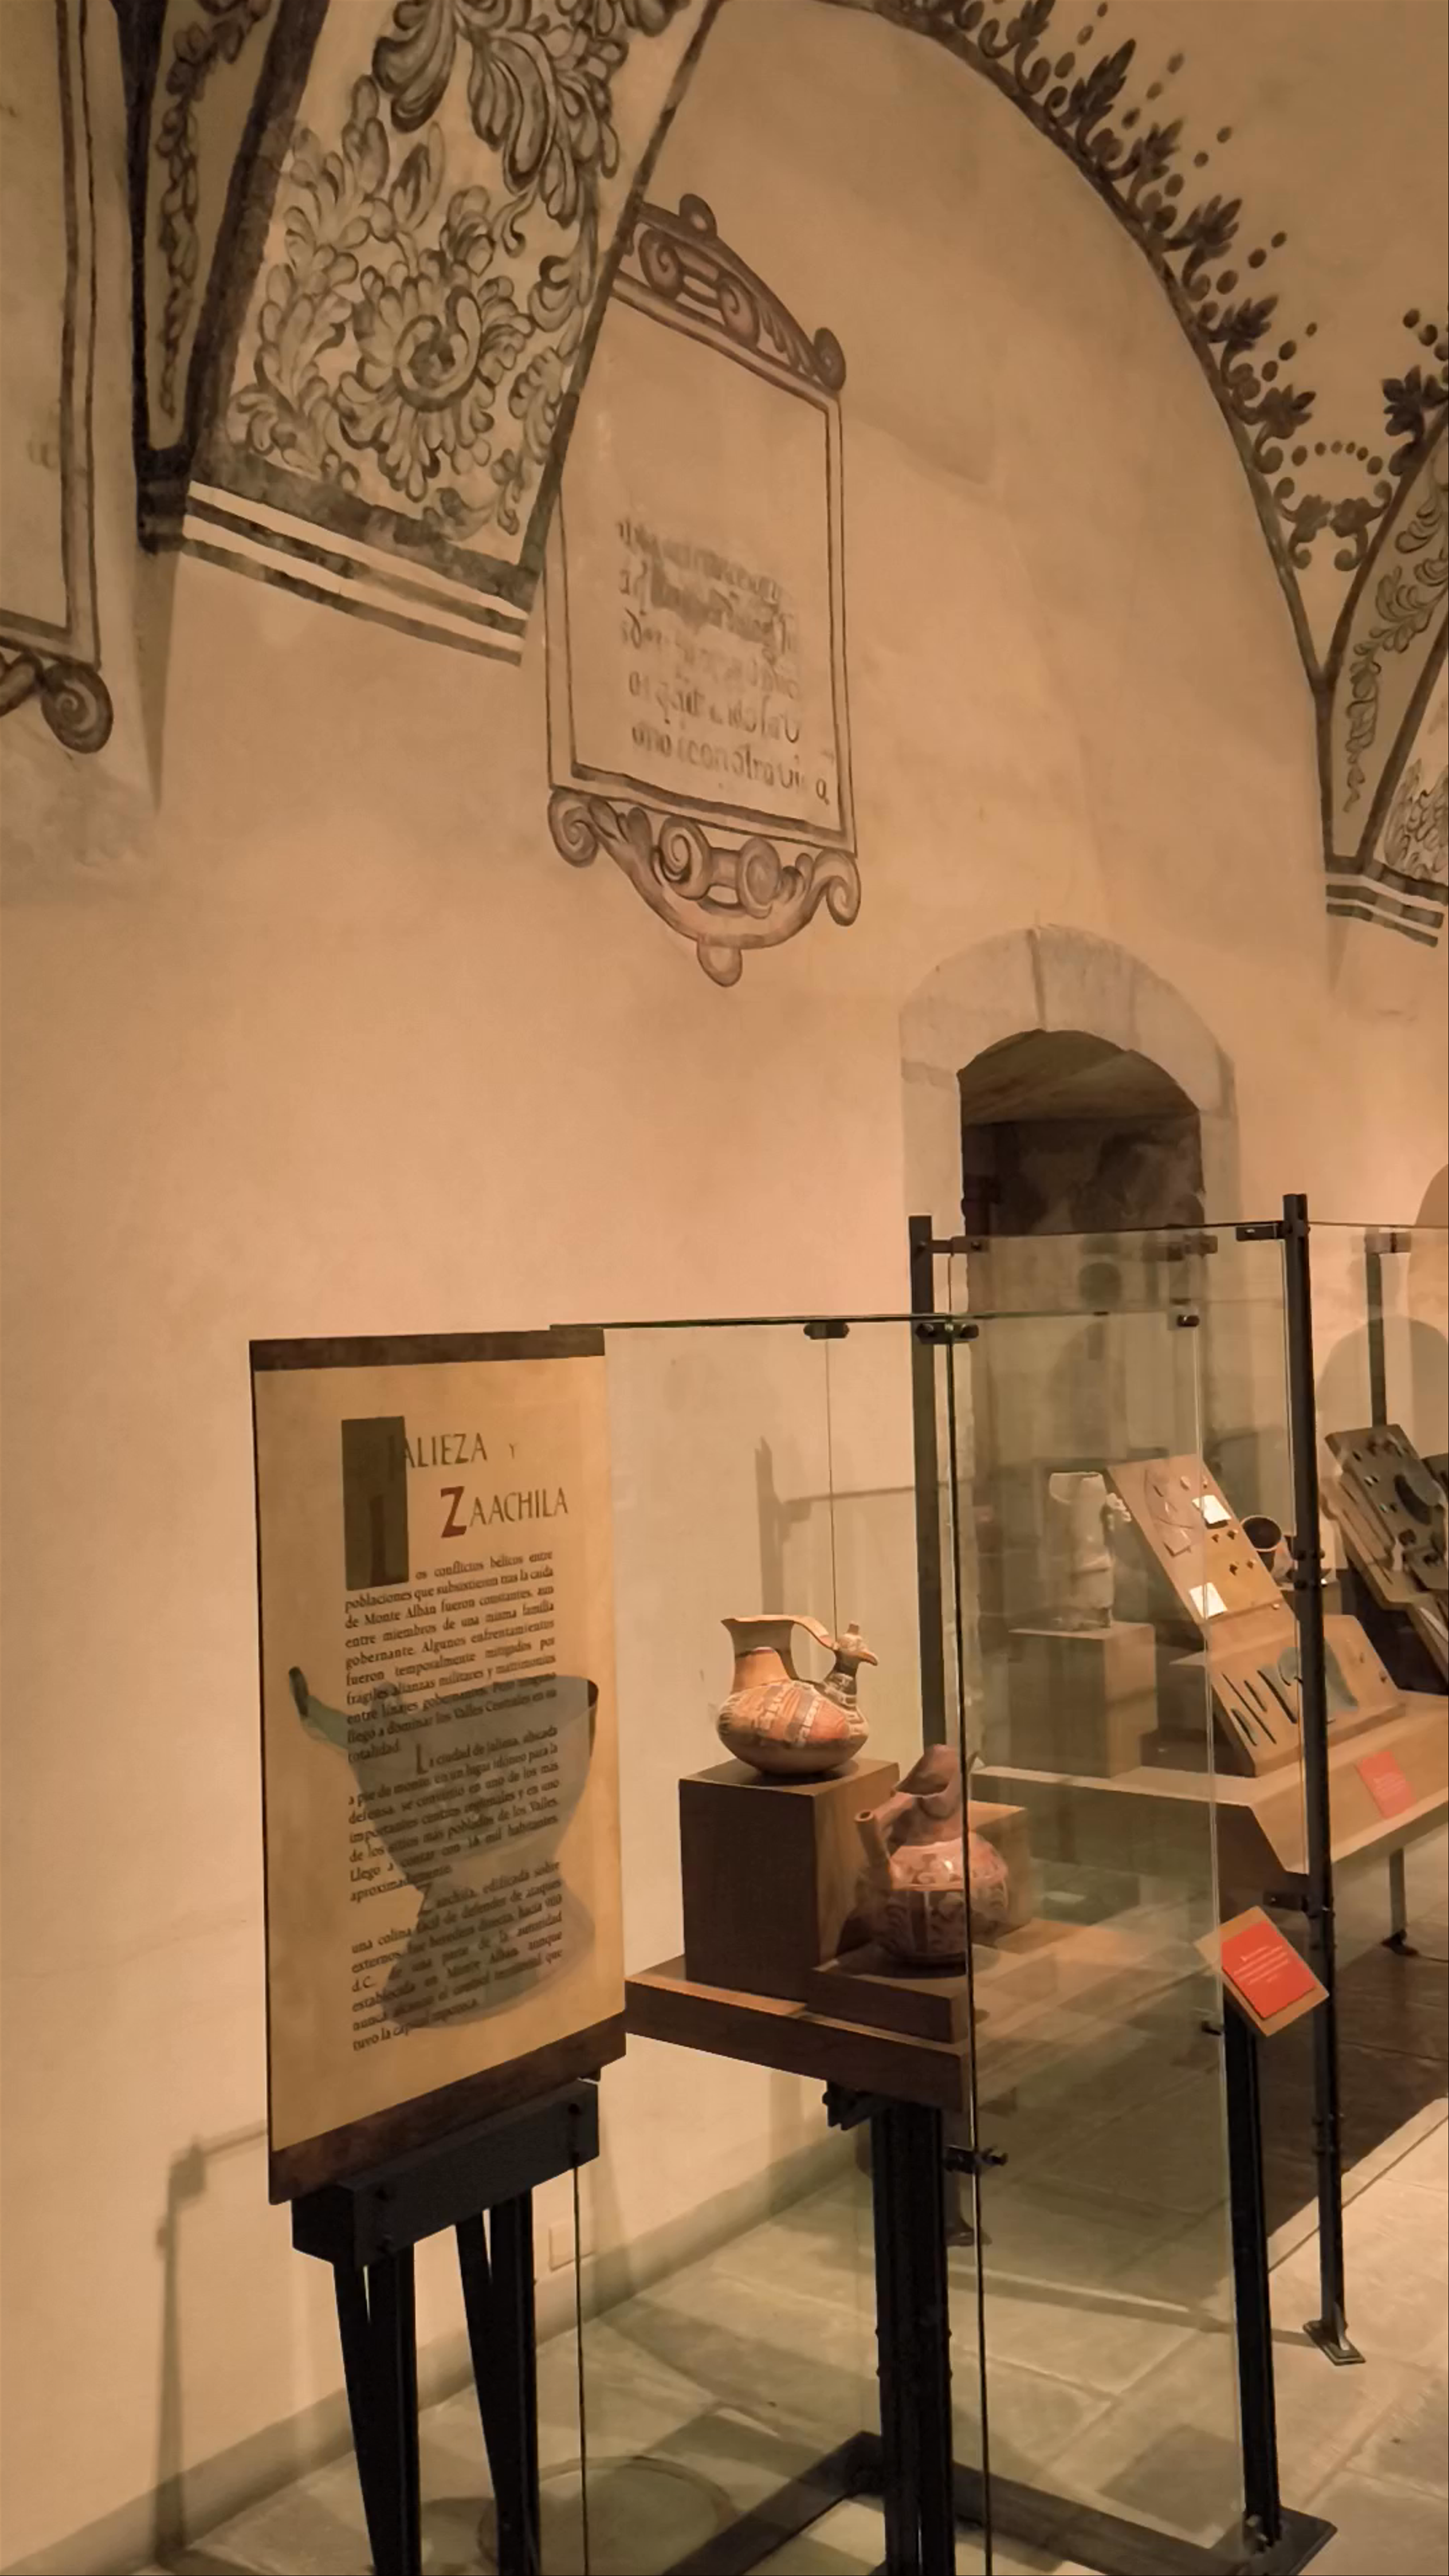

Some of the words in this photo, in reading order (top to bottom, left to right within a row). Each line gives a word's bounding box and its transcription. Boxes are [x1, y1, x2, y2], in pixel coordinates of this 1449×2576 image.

[434, 1561, 484, 1577] conflictos
[529, 1551, 553, 1563] entre
[345, 1592, 412, 1614] poblaciones
[414, 1588, 434, 1601] que
[520, 1569, 528, 1581] la
[345, 1614, 358, 1629] de
[365, 1612, 400, 1624] Monte
[441, 1599, 475, 1612] fueron
[345, 1635, 375, 1648] entre
[383, 1624, 437, 1641] miembros
[443, 1618, 455, 1630] de
[461, 1616, 479, 1627] una
[486, 1610, 517, 1622] misma
[523, 1601, 554, 1615] familia
[422, 1638, 466, 1653] Algunos
[471, 1620, 554, 1643] enfrentamientos
[346, 1671, 385, 1686] fueron
[395, 1653, 476, 1676] temporalmente
[540, 1637, 555, 1650] por
[439, 1670, 483, 1686] militares
[487, 1668, 492, 1677] y
[346, 1710, 377, 1724] entre
[378, 1728, 384, 1736] a
[454, 1706, 483, 1719] Valles
[532, 1692, 544, 1701] en
[436, 1744, 471, 1765] ciudad
[472, 1743, 484, 1756] de
[348, 1796, 354, 1805] a
[377, 1784, 391, 1798] de
[434, 1774, 448, 1783] en
[450, 1770, 463, 1780] un
[466, 1764, 490, 1777] lugar
[529, 1748, 548, 1763] para
[550, 1743, 558, 1754] la
[469, 1783, 480, 1793] en
[486, 1777, 505, 1789] uno
[508, 1771, 519, 1783] de
[524, 1768, 537, 1778] los
[526, 1787, 538, 1795] en
[541, 1781, 560, 1791] uno
[349, 1849, 363, 1862] de
[368, 1844, 384, 1857] los
[498, 1810, 509, 1821] de
[513, 1806, 526, 1816] los
[388, 1863, 393, 1871] a
[441, 1844, 461, 1856] con
[485, 1828, 501, 1844] mil
[352, 1939, 373, 1954] una
[378, 1928, 411, 1945] colina
[510, 1890, 521, 1902] de
[499, 1930, 508, 1942] la
[546, 1950, 562, 1964] que
[352, 2035, 379, 2051] tuvo
[381, 2028, 391, 2041] la
